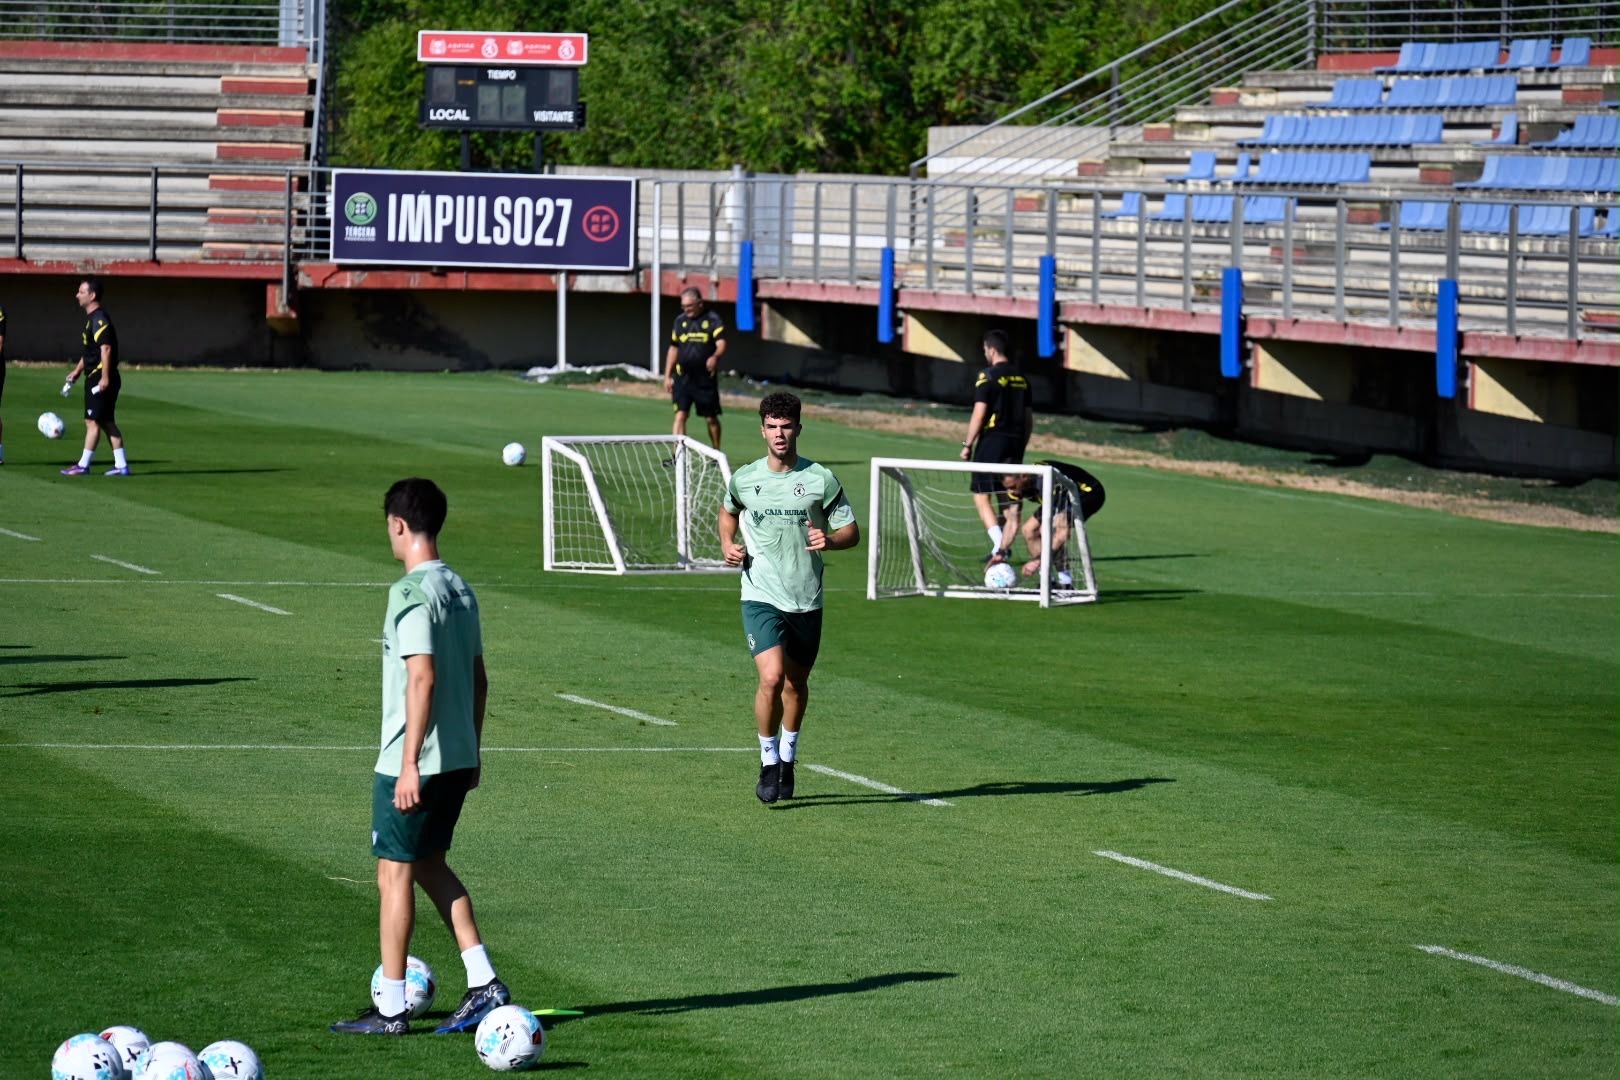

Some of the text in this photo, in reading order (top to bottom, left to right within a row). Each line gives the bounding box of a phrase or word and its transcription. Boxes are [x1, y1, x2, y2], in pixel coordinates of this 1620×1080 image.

[487, 69, 517, 80] TIEMPO
[429, 109, 470, 120] LOCAL
[533, 110, 574, 123] VISITANTE
[388, 193, 573, 247] IMPULSO27
[764, 508, 808, 517] CAJA RURAL
